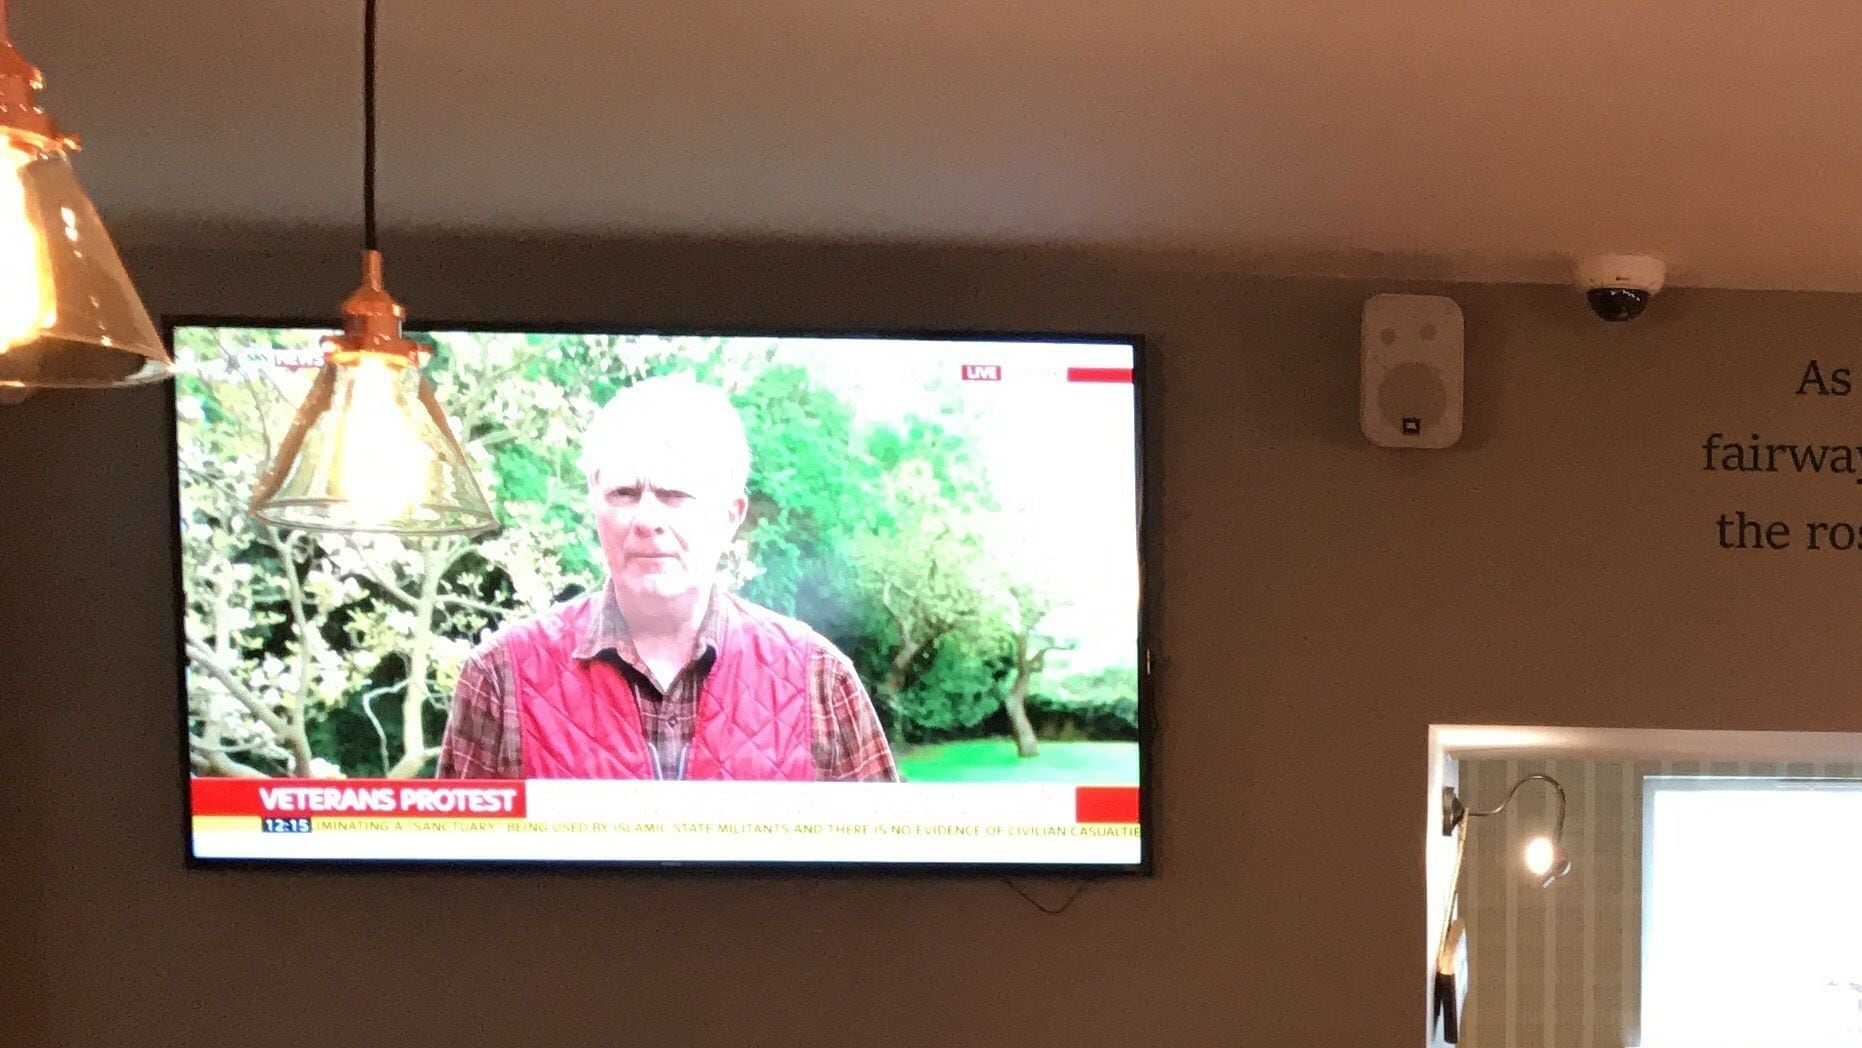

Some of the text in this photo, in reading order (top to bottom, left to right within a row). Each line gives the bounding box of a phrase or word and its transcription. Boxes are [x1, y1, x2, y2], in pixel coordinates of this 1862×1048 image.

[1794, 359, 1853, 397] As
[1715, 510, 1791, 551] the
[259, 787, 518, 812] VETERANS PROTEST
[264, 818, 311, 832] 12:15
[312, 821, 389, 832] IMINATING
